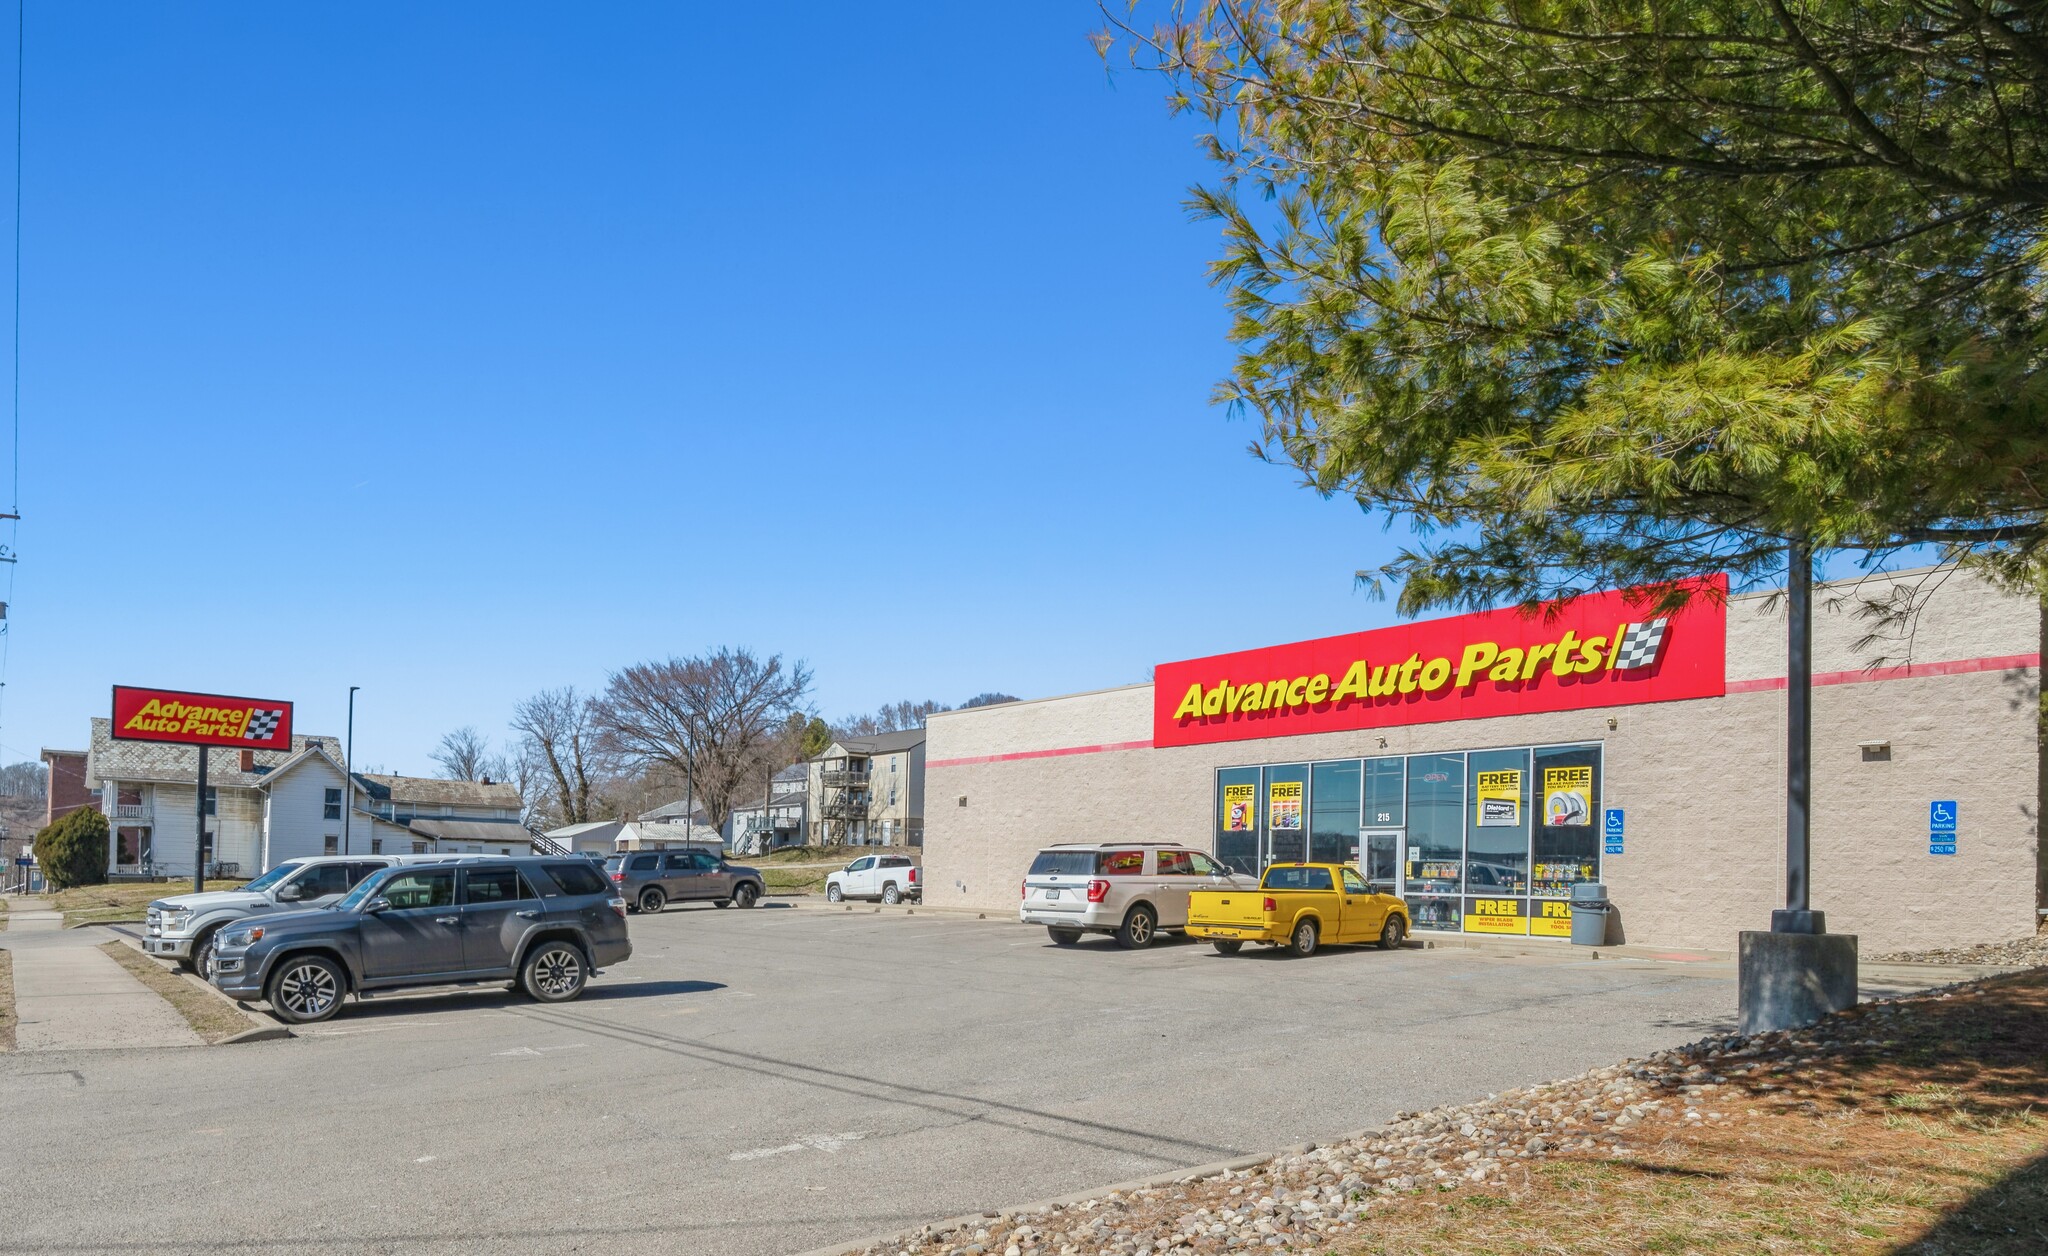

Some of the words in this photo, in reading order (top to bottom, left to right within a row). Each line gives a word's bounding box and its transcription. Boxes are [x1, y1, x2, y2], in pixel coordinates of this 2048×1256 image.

[1173, 673, 1331, 719] Advance
[1330, 652, 1450, 701] Auto
[1455, 630, 1608, 687] Parts
[139, 699, 243, 723] Advance
[124, 715, 181, 733] Auto
[181, 719, 238, 738] Parts
[1424, 773, 1447, 782] OPEN
[1480, 772, 1518, 785] FREE
[1547, 769, 1589, 782] FREE
[1226, 786, 1253, 796] FREE
[1272, 787, 1301, 797] FREE
[1377, 813, 1390, 821] 215
[1475, 900, 1517, 915] FREE
[1542, 901, 1572, 917] FR
